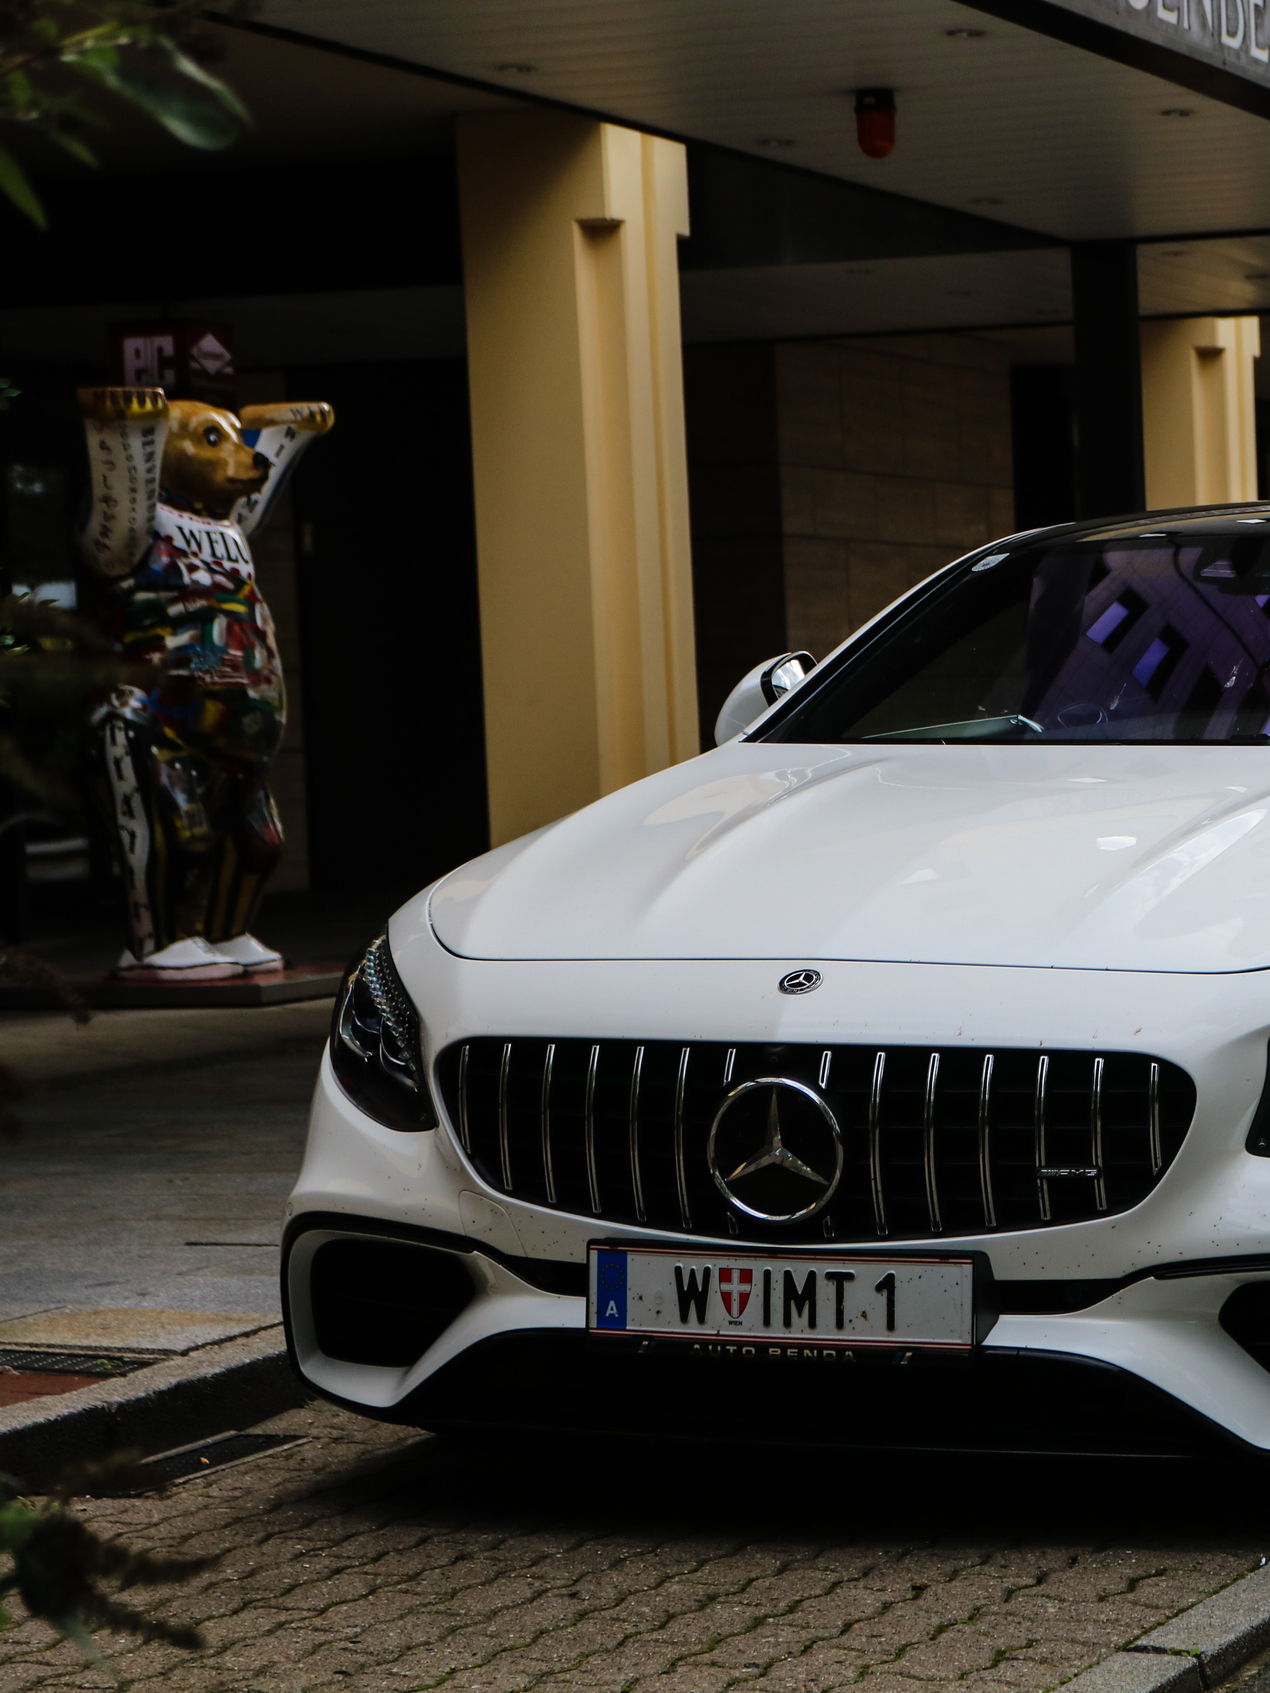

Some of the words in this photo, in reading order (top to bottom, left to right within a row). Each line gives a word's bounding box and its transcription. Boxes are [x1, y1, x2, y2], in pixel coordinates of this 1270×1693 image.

[674, 1265, 711, 1324] W
[763, 1266, 856, 1329] IMT
[875, 1272, 899, 1331] 1
[604, 1300, 619, 1318] A
[691, 1344, 757, 1359] AUTO
